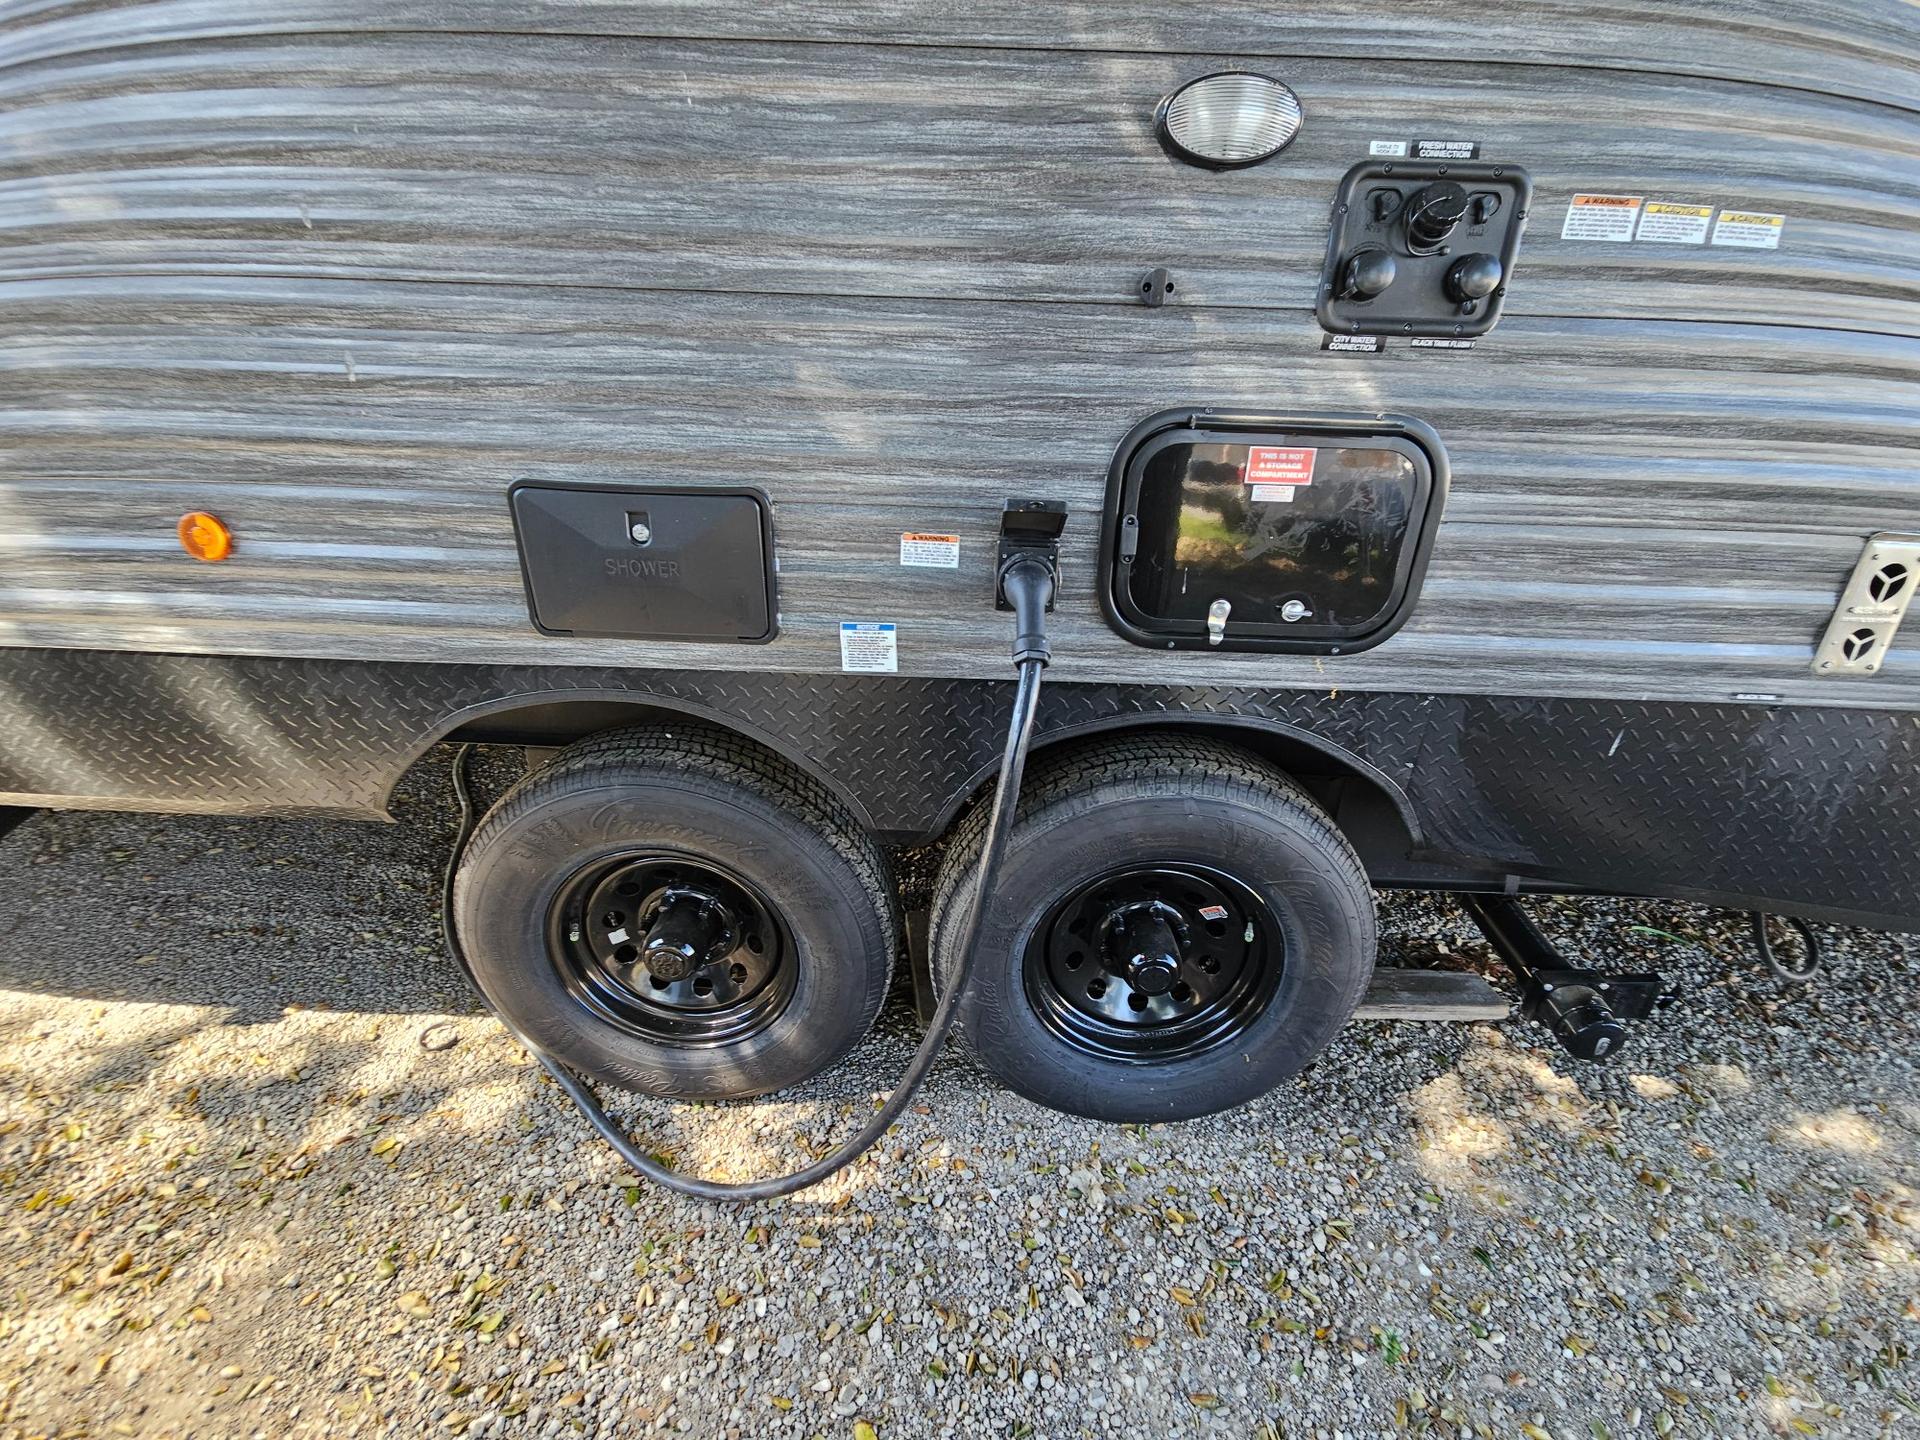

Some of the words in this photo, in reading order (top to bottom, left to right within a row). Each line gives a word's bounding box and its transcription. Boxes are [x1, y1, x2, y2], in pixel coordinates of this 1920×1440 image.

[1419, 141, 1446, 150] FRESH
[1446, 141, 1474, 150] WATER
[1419, 149, 1472, 158] CONNECTION
[1332, 336, 1350, 344] CITY
[1350, 336, 1377, 344] WATER
[1328, 343, 1377, 351] CONNECTION
[1250, 471, 1309, 479] COMPARTMENT
[604, 558, 681, 578] SHOWER
